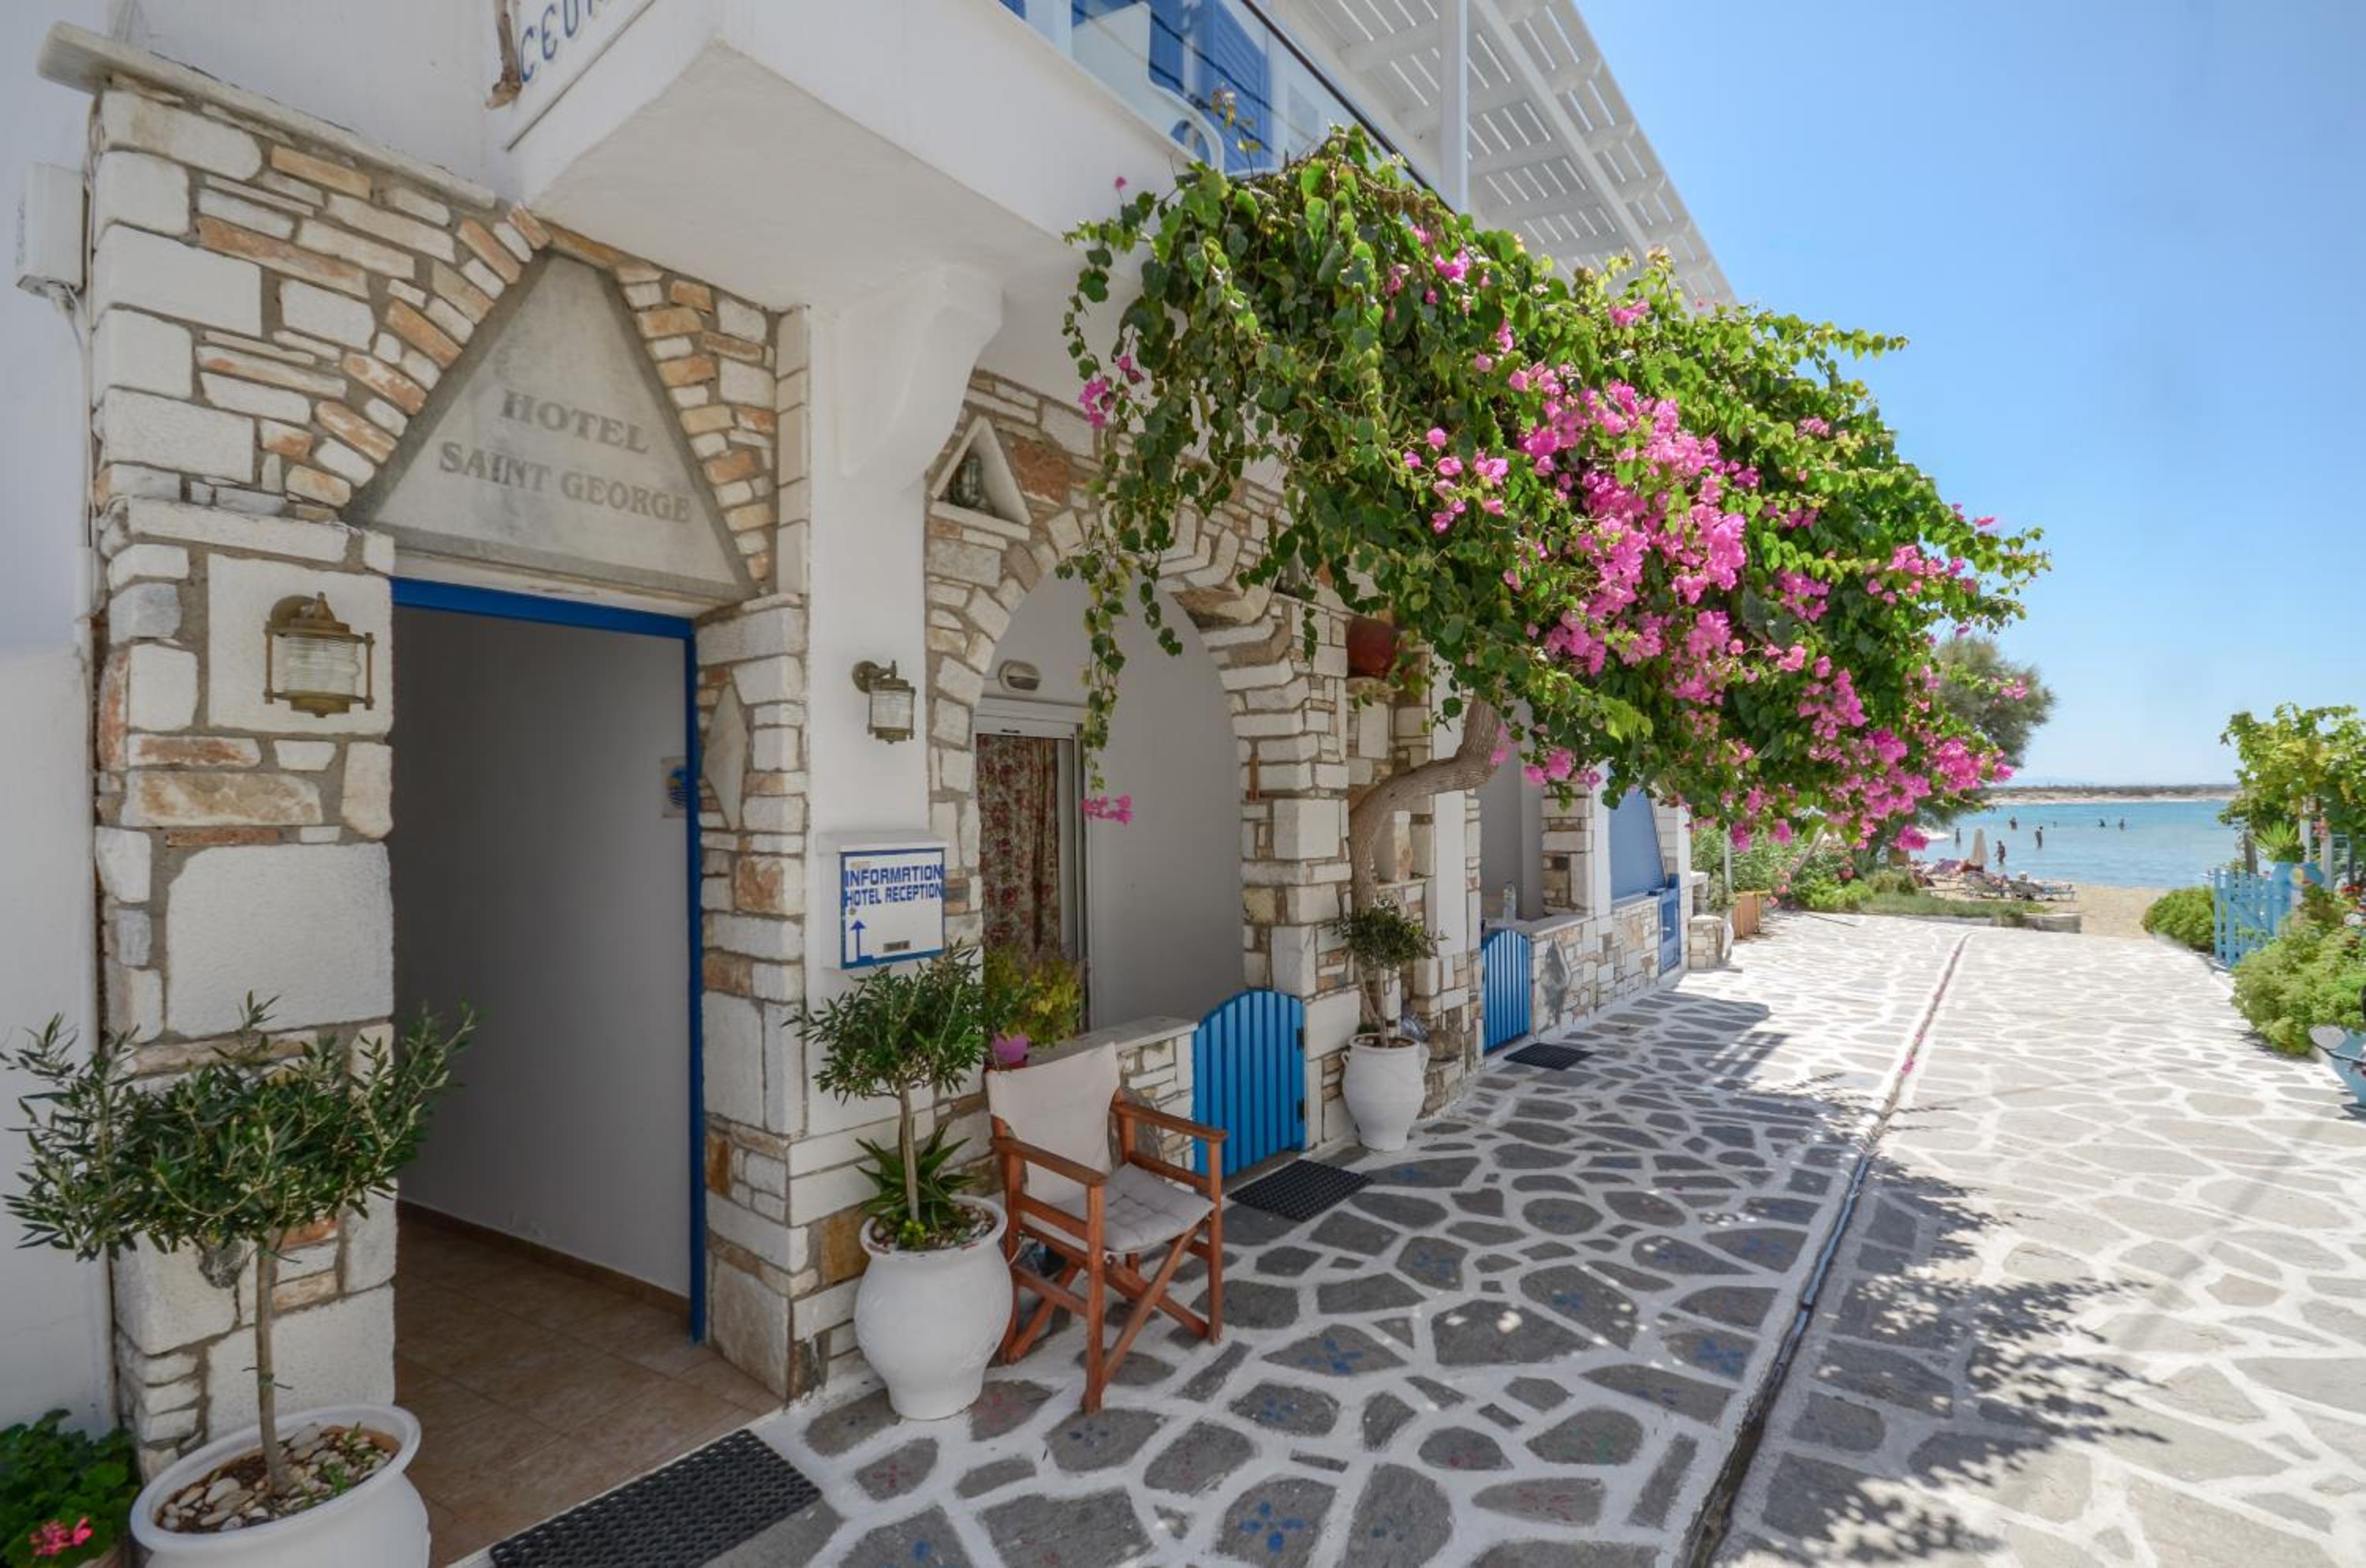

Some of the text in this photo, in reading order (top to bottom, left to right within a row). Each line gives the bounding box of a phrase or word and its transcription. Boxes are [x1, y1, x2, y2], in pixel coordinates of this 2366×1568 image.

[500, 389, 650, 454] HOTEL
[438, 441, 691, 523] SAINT GEORGE
[844, 883, 944, 907] HOTEL RECEPTION
[845, 864, 945, 887] INFORMATION
